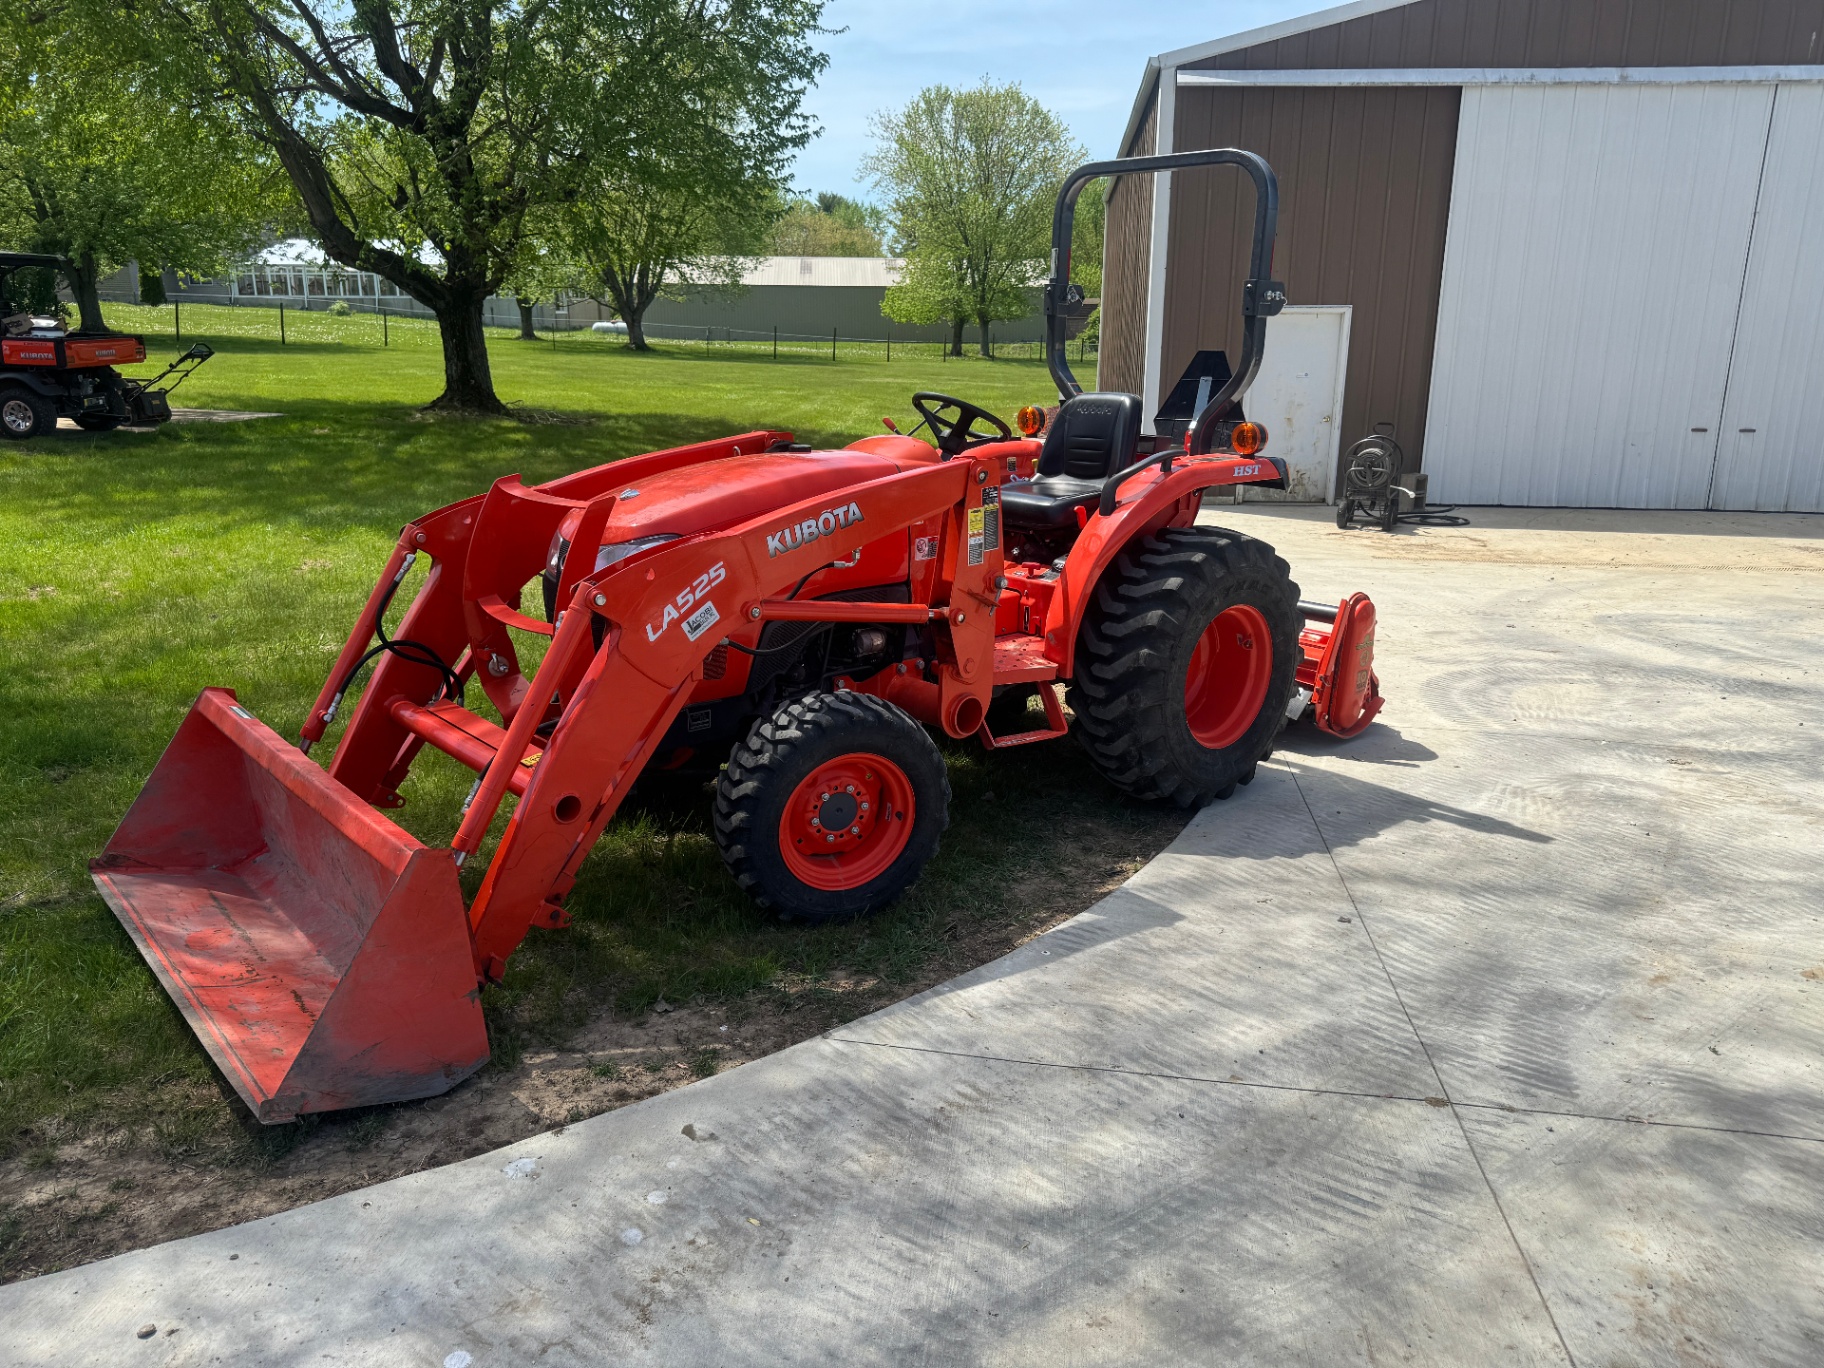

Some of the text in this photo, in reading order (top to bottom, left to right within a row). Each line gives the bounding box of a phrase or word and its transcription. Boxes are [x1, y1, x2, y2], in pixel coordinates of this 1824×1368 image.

[21, 352, 54, 360] KUBOTA
[1233, 464, 1262, 477] HST
[766, 501, 864, 558] KUBOTA
[646, 561, 726, 642] LA525
[686, 605, 713, 634] JACOBI
